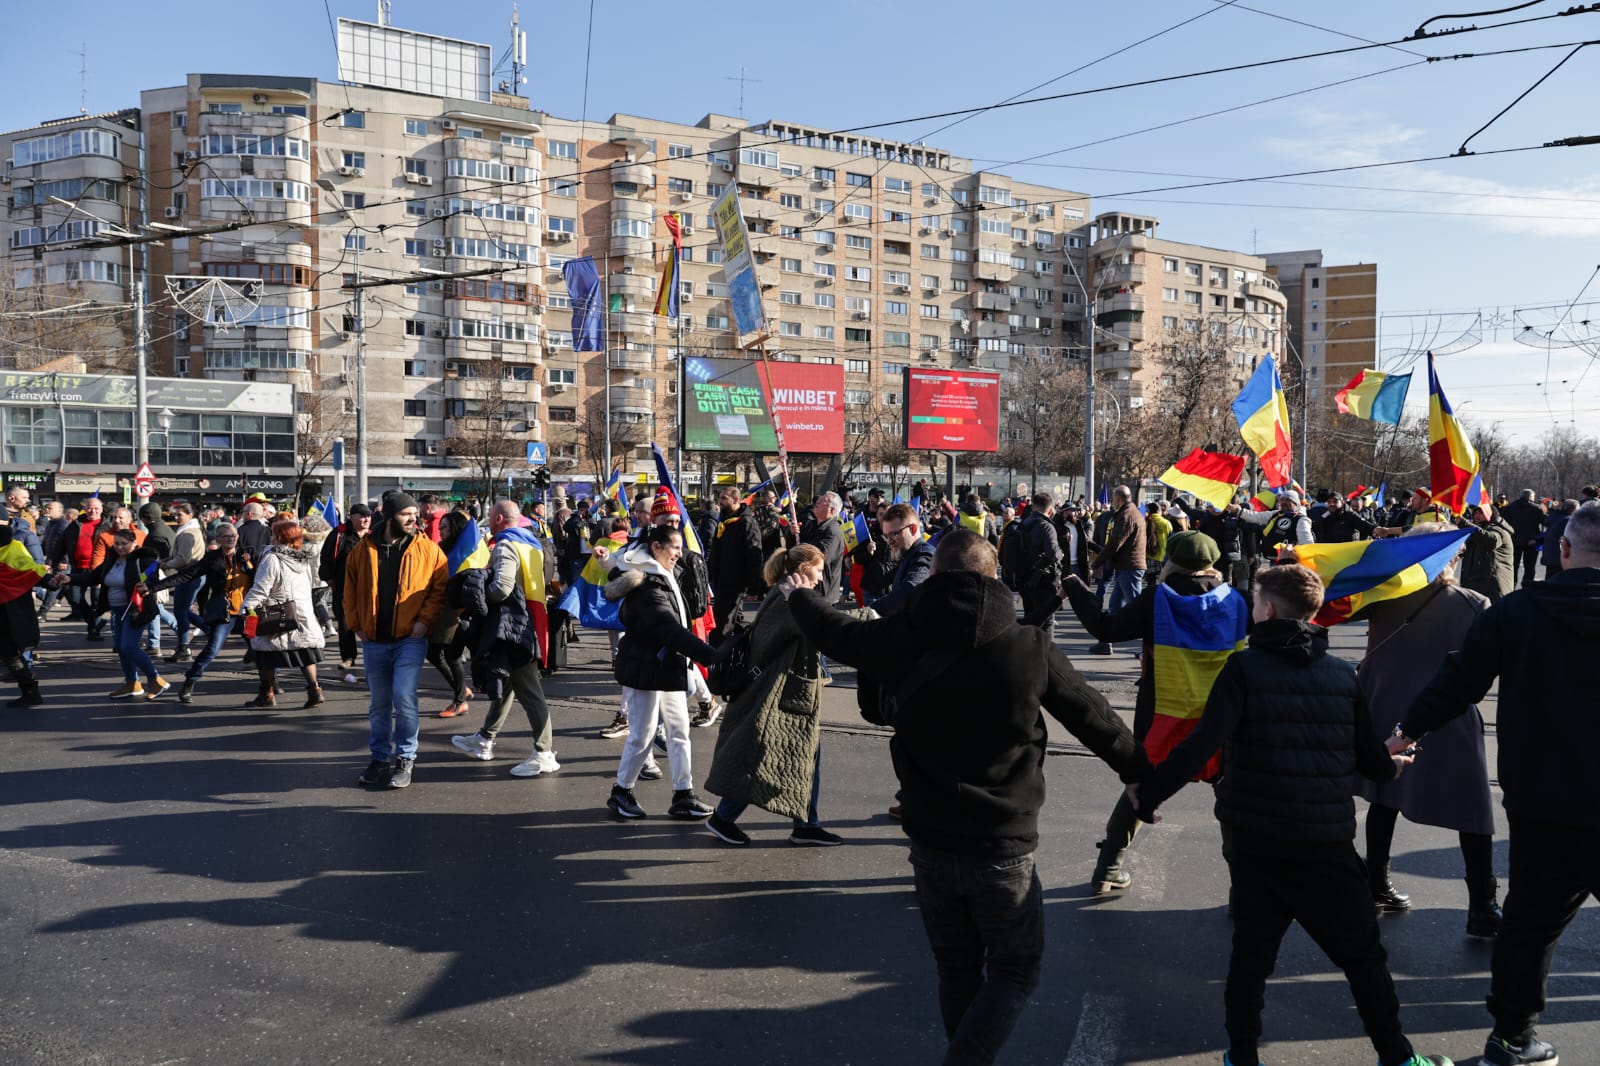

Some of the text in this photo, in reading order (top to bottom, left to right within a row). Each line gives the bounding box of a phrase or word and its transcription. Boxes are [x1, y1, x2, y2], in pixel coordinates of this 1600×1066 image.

[696, 391, 726, 401] CASH
[773, 388, 837, 406] WINBET
[698, 400, 727, 413] OUT
[731, 395, 760, 408] OUT
[785, 422, 825, 431] winbet.ro
[8, 474, 48, 482] FRENZY
[852, 474, 909, 484] MEGA IMGE
